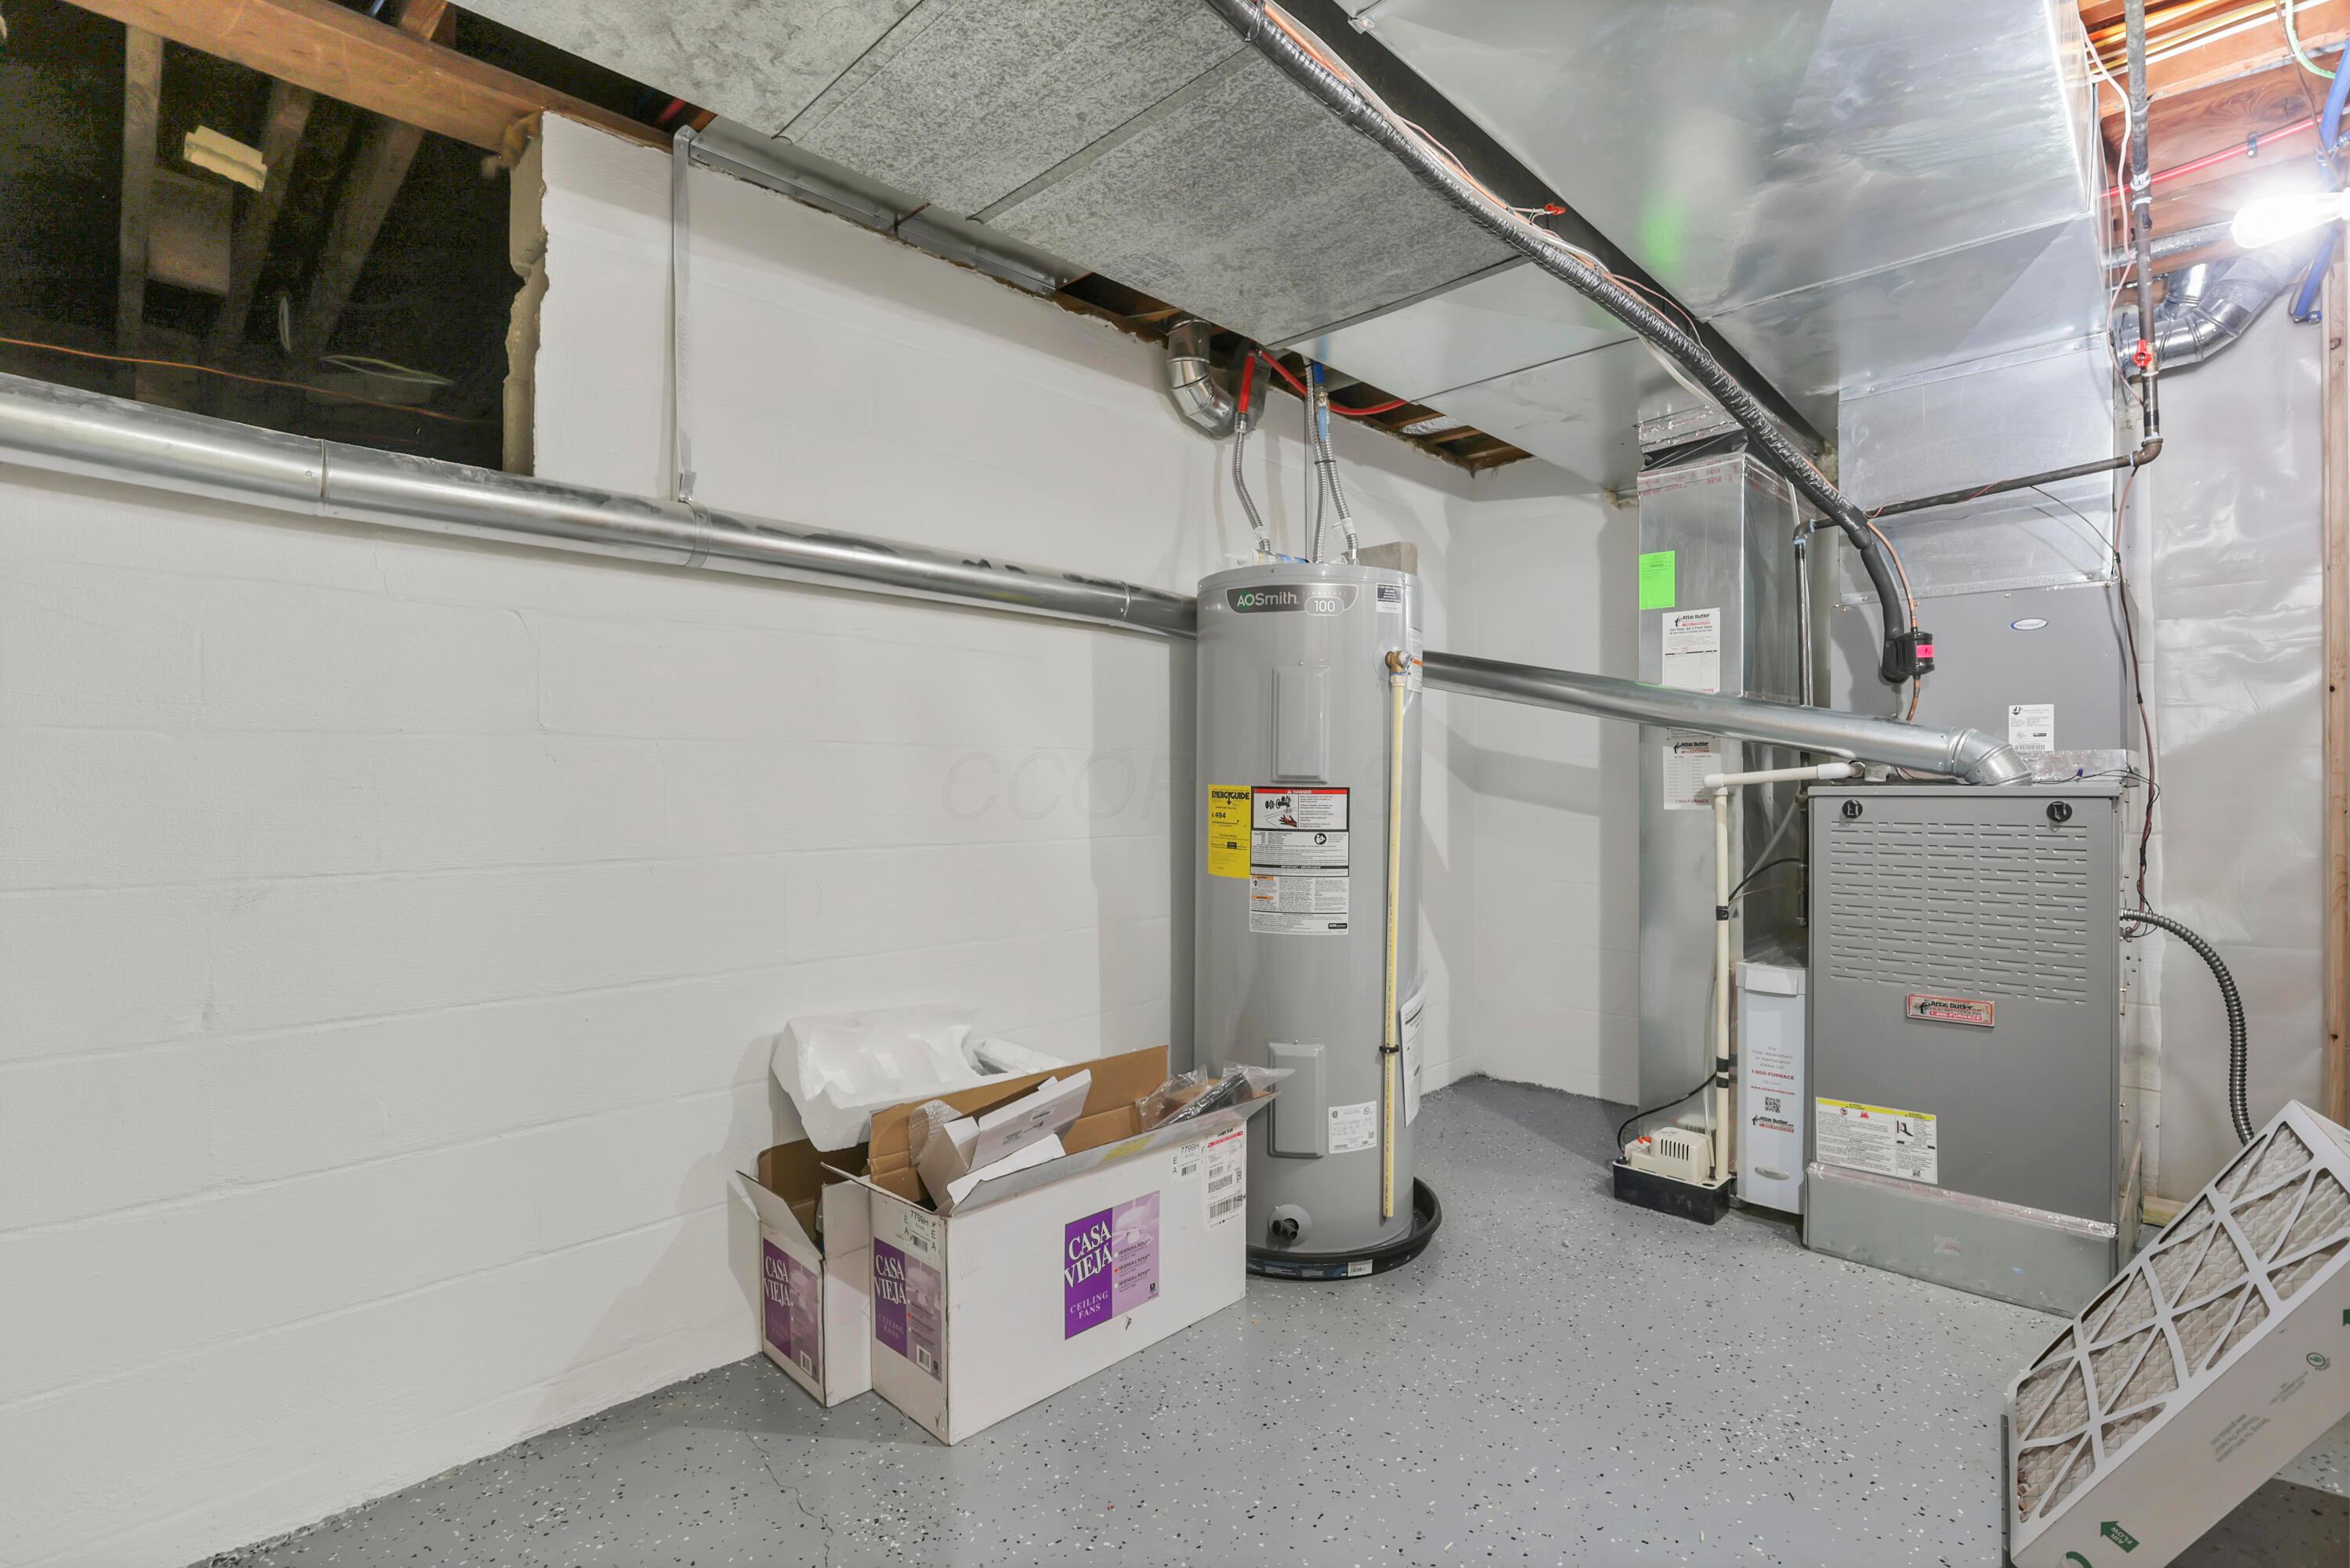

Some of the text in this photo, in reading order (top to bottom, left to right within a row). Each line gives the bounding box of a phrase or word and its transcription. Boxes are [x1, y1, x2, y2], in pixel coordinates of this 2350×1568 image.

[1314, 600, 1336, 612] 100
[1930, 1011, 1982, 1021] 1-800-FURNACE
[1752, 1068, 1794, 1080] 1-800-FURNACE
[1068, 1220, 1112, 1261] CASA
[765, 1255, 790, 1283] CASA
[875, 1255, 906, 1281] CASA
[1064, 1245, 1113, 1288] VIEJA
[764, 1278, 790, 1307] VIEJA
[873, 1277, 907, 1306] VIEJA
[1070, 1291, 1108, 1314] CEILING
[1079, 1302, 1101, 1320] FANS
[2110, 1527, 2133, 1545] FLOW
[2110, 1533, 2124, 1544] AIR
